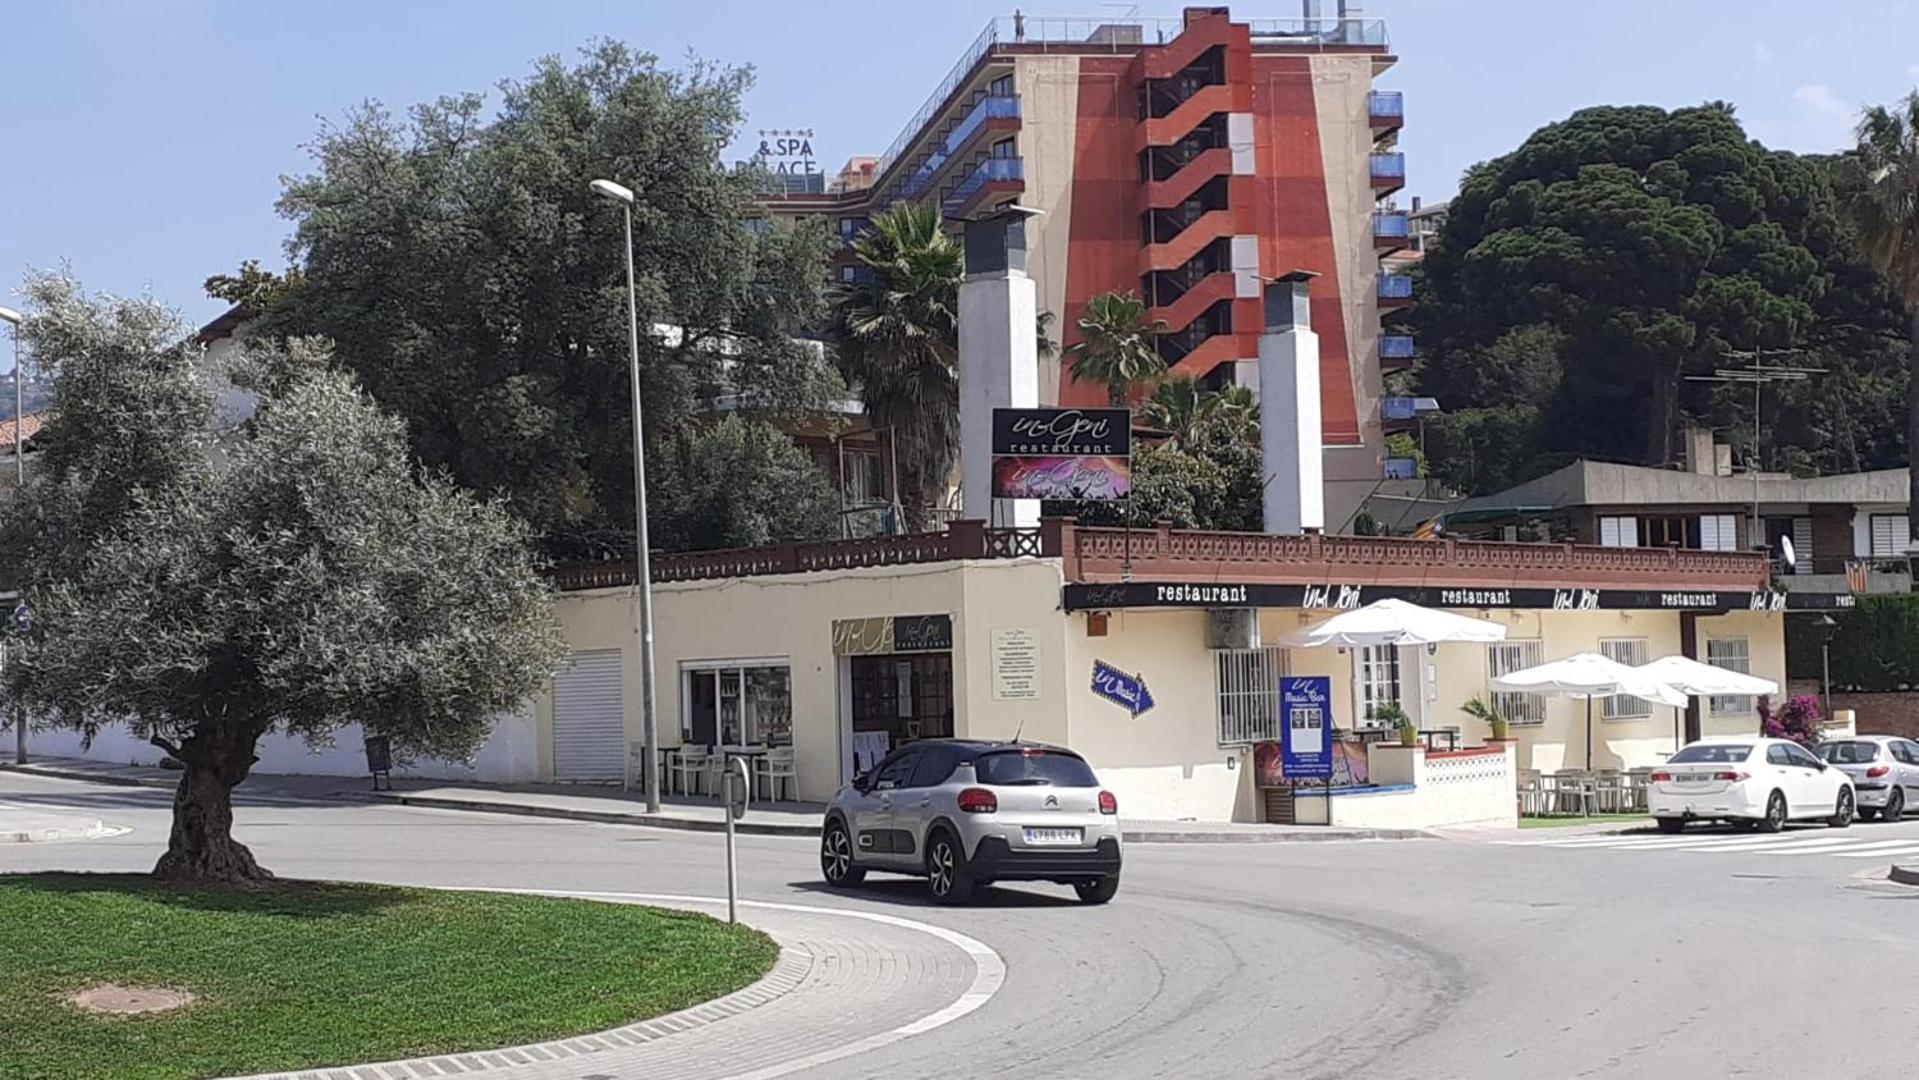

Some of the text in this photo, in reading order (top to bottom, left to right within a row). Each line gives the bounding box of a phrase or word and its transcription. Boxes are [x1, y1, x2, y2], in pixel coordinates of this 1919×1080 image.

[759, 138, 813, 156] & SPA
[1010, 444, 1112, 453] restaurant
[1157, 584, 1247, 602] restaurant
[1441, 589, 1511, 604] restaurant
[1661, 593, 1717, 606] restaurant
